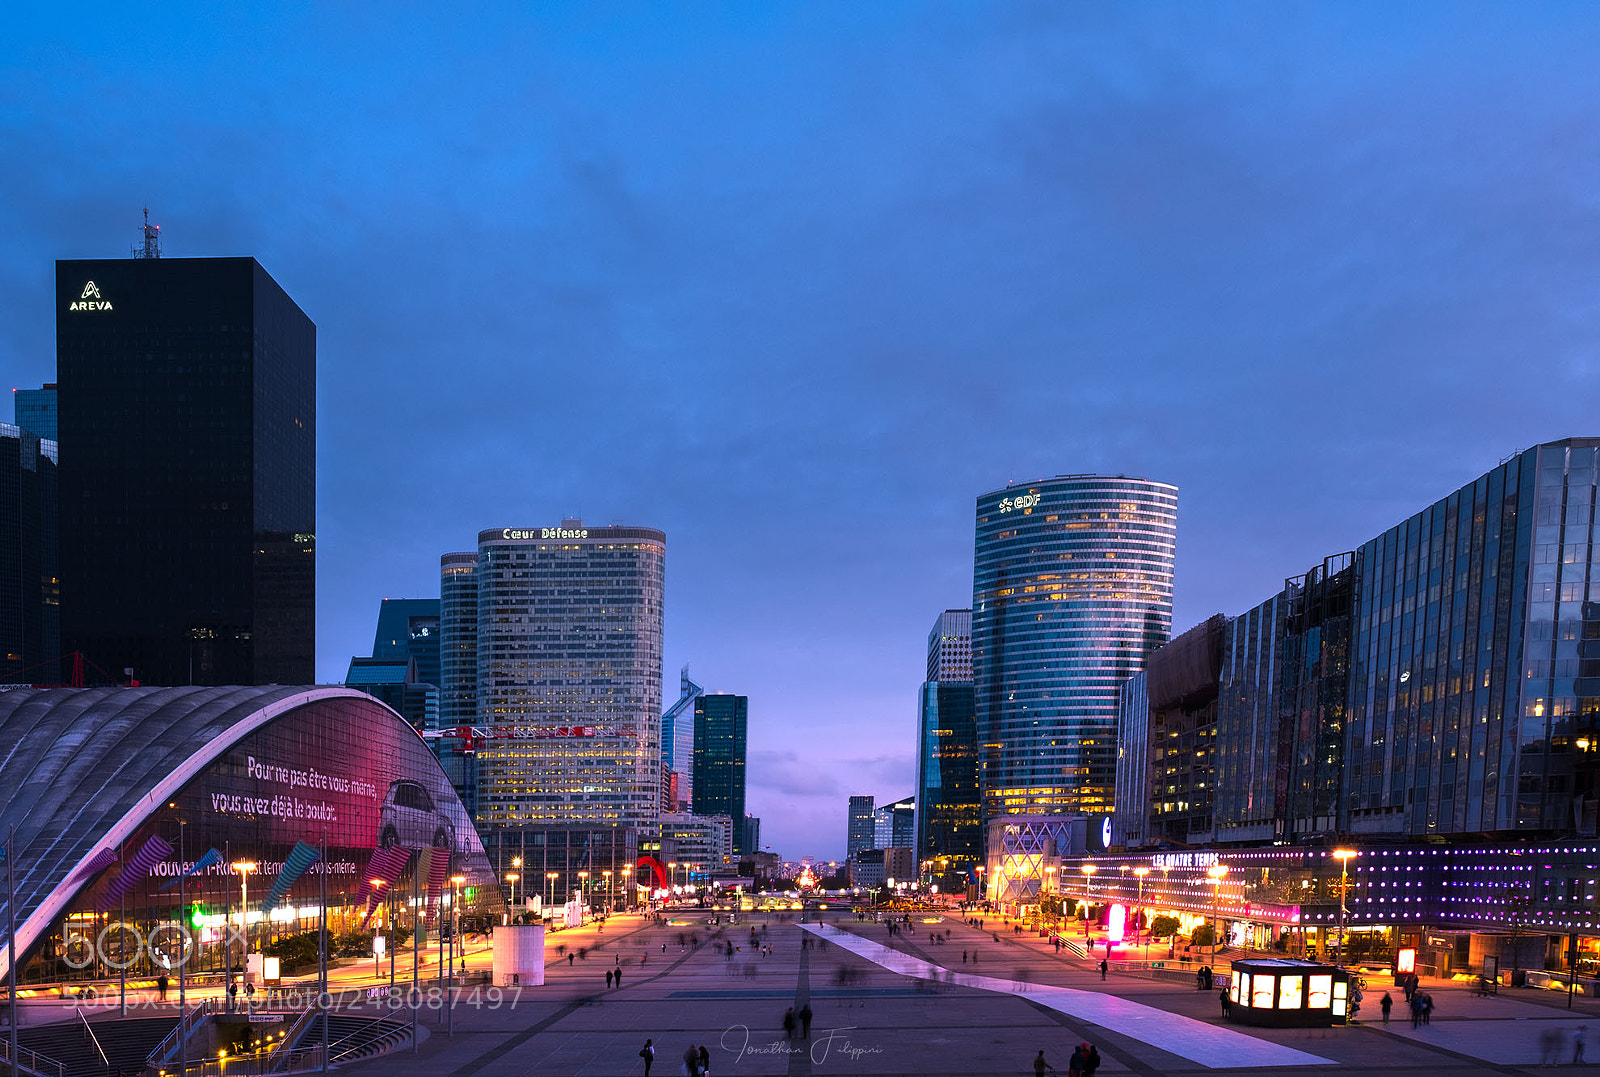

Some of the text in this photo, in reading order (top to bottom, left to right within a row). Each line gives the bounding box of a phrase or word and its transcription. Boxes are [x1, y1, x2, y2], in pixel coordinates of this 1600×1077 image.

[69, 301, 113, 311] AREVA
[541, 527, 588, 539] Défense
[247, 755, 274, 781] Pour
[275, 766, 289, 783] ne
[290, 769, 308, 790] pas
[308, 767, 327, 790] être
[211, 792, 241, 812] vous
[243, 796, 270, 815] avez
[270, 794, 293, 822] déjà
[294, 797, 305, 818] le
[1152, 852, 1219, 867] LES QUATRE TEMPS
